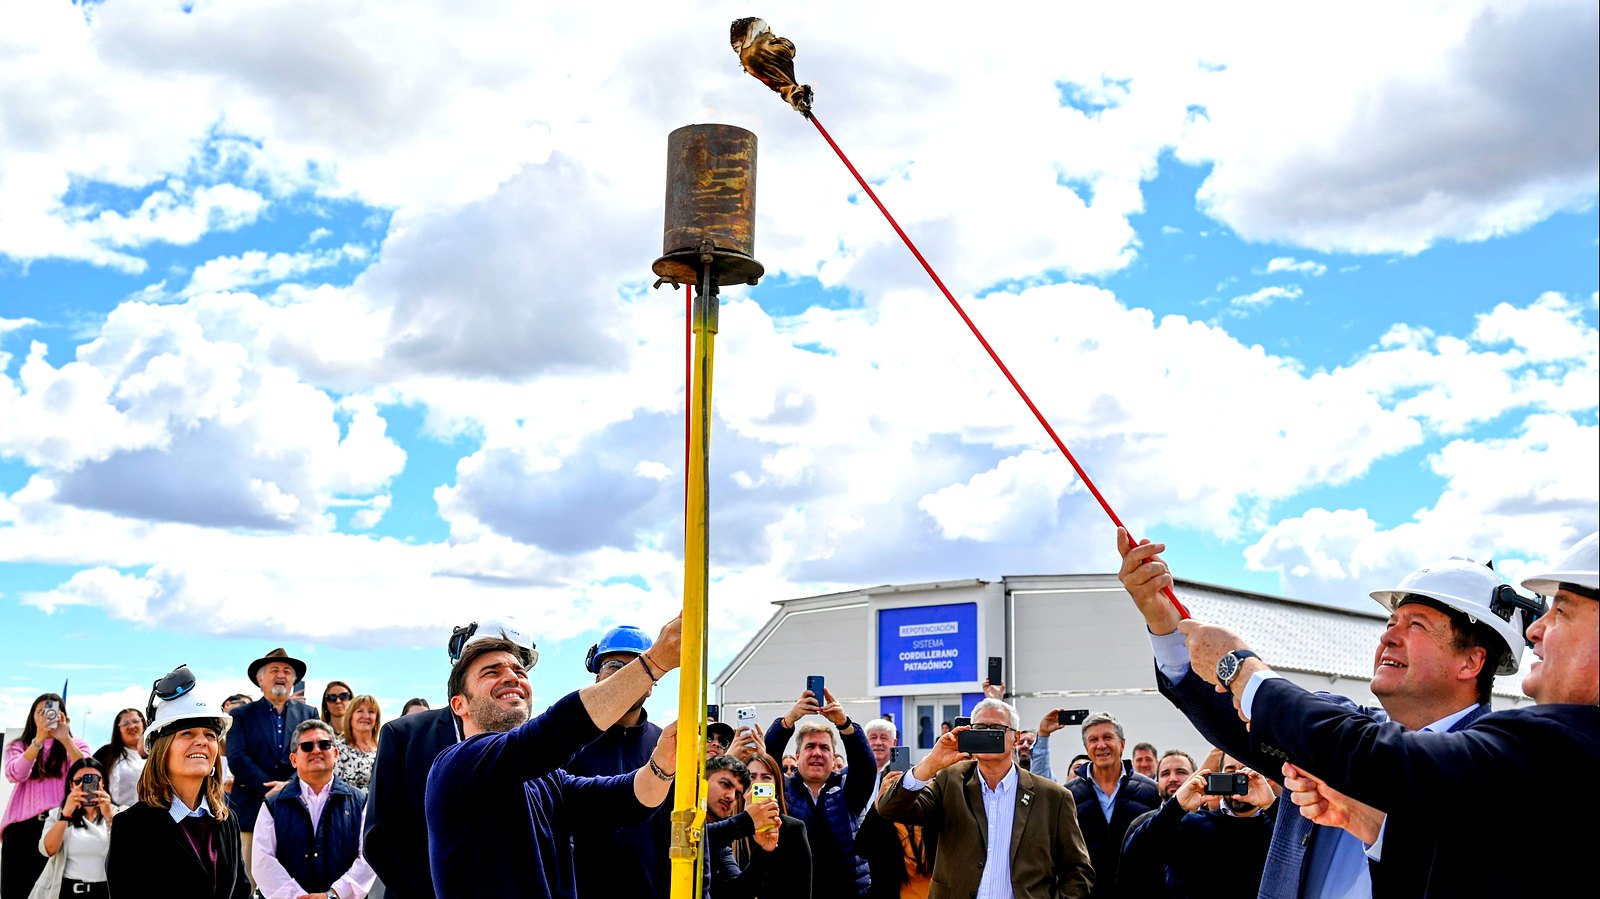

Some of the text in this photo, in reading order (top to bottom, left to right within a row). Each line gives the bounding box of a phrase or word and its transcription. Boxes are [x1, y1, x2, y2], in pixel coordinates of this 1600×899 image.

[902, 624, 956, 634] REPOTENCIACIÓN
[913, 639, 944, 649] SISTEMA
[899, 649, 958, 660] CORDILLERANO
[904, 660, 953, 671] PATAGÓNICO
